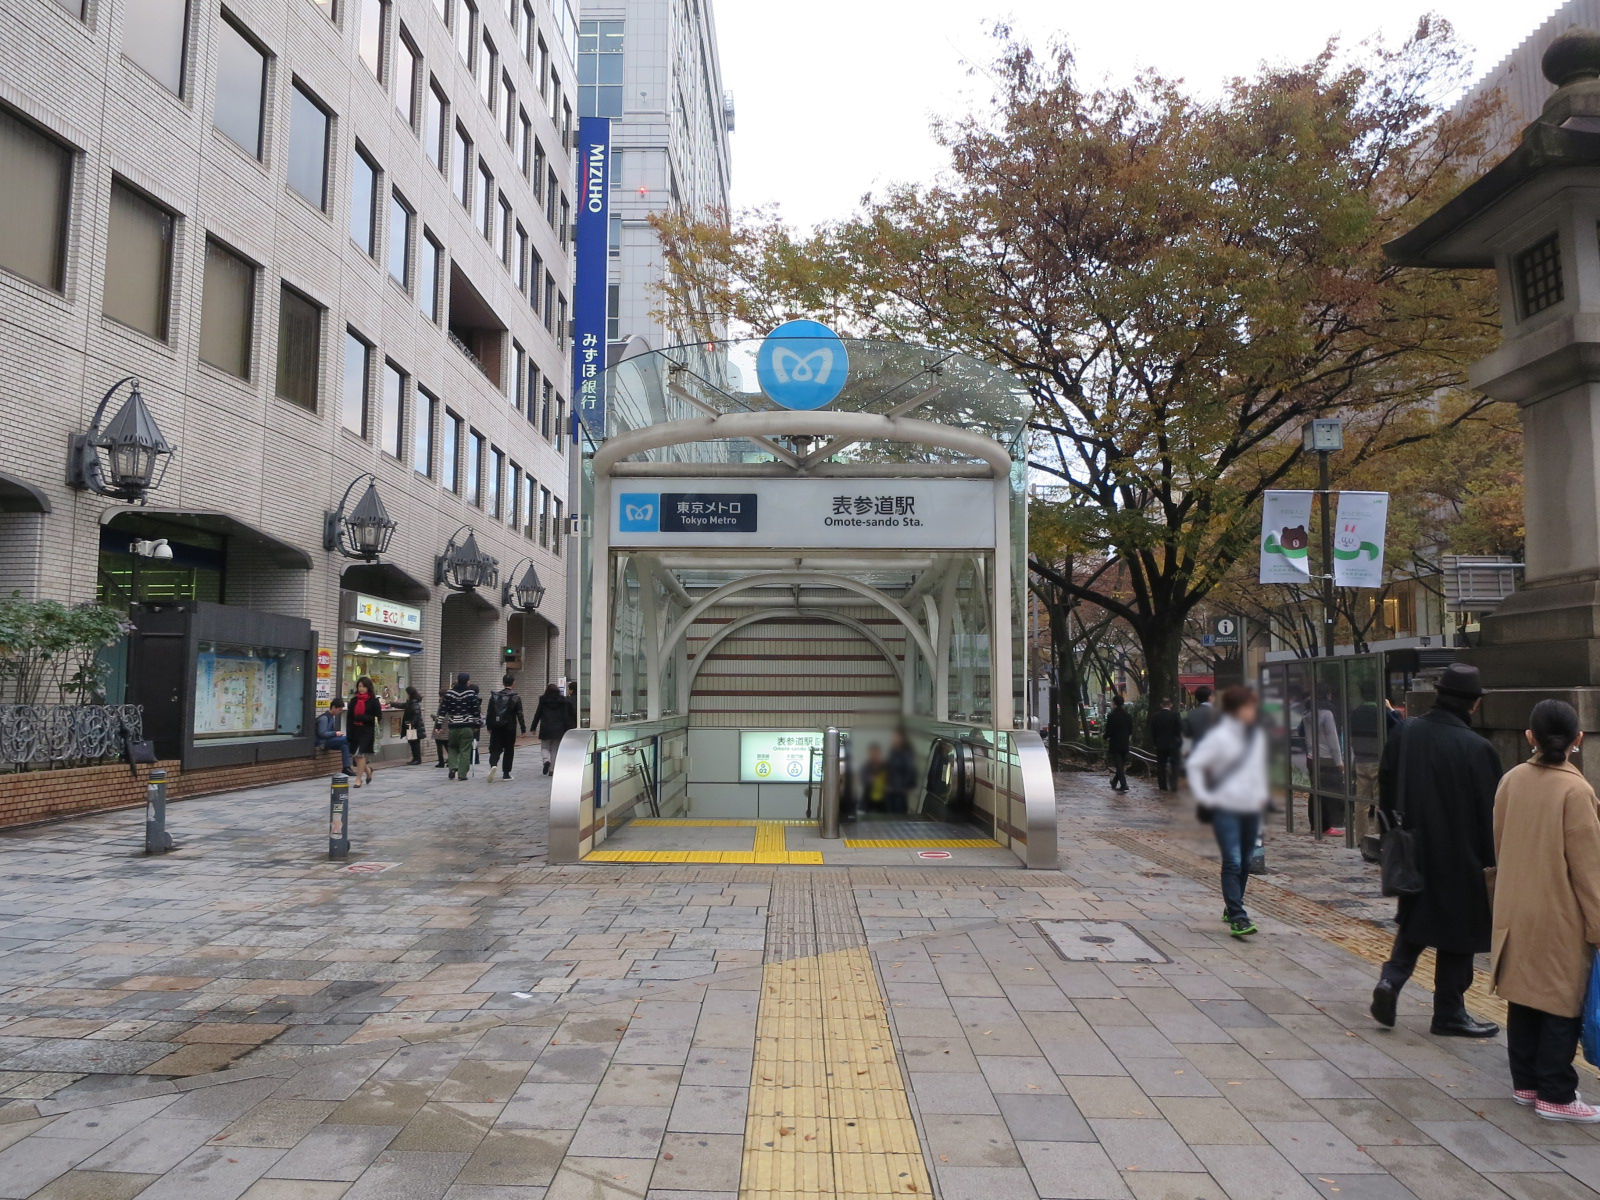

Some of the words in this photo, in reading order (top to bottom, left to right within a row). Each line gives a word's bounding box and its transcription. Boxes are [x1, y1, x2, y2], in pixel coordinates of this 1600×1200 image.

[588, 143, 605, 213] MIZUHO
[581, 333, 598, 410] みずほ銀行
[676, 501, 741, 514] 東京メトロ
[832, 495, 915, 516] 表参道駅
[680, 515, 708, 526] Tokyo
[709, 515, 737, 525] Metro
[824, 516, 900, 527] Omote-sando
[902, 517, 924, 527] Sta.
